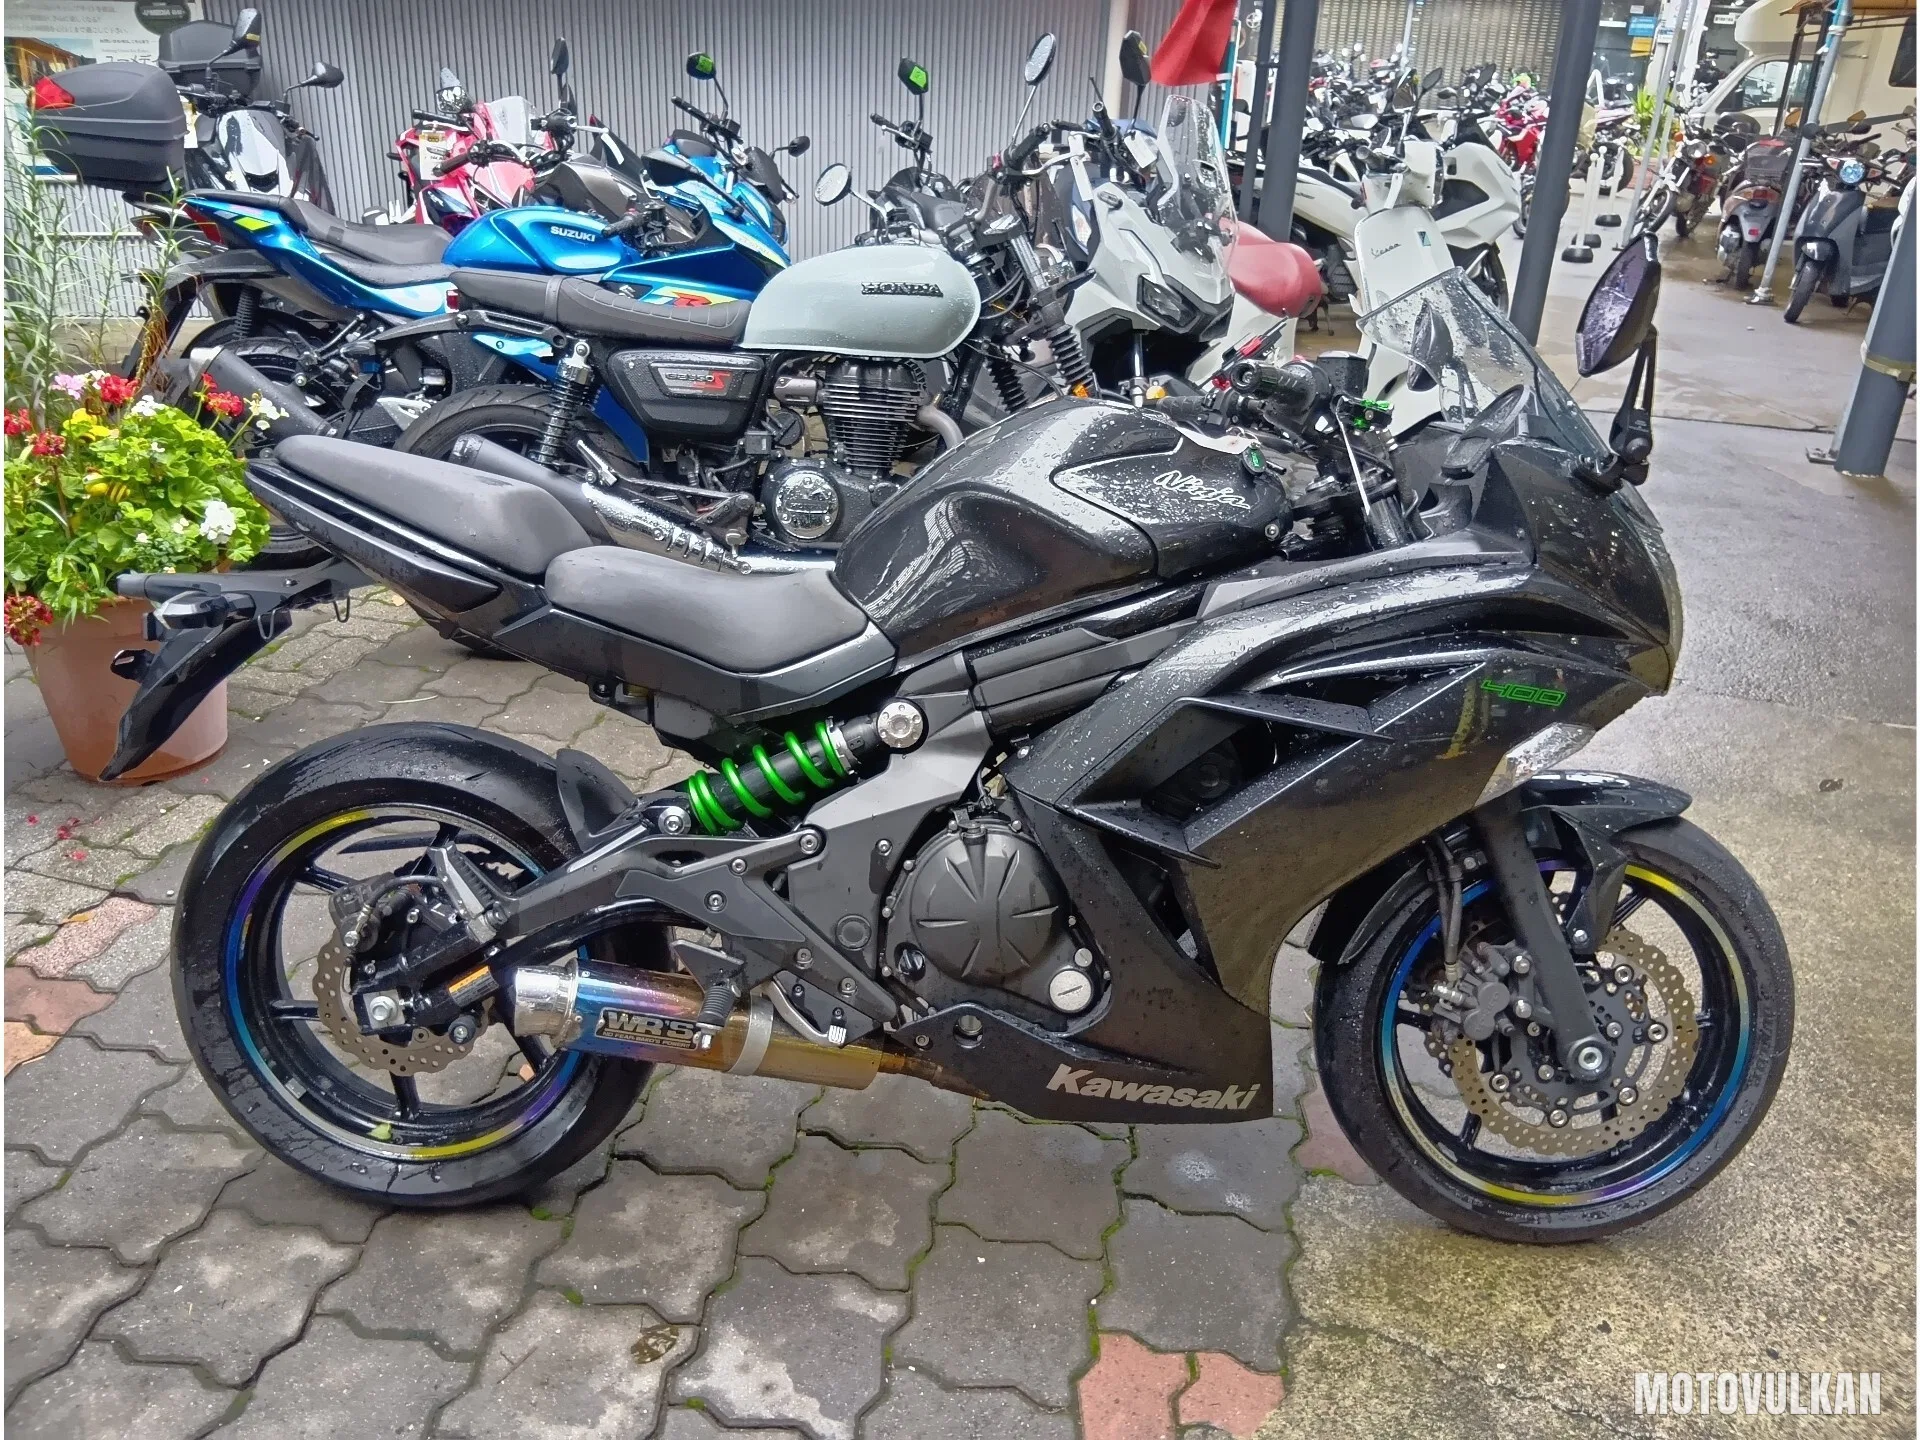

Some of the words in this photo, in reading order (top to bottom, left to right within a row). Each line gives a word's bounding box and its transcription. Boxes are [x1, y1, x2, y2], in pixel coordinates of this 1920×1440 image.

[550, 226, 596, 242] SUZUKI
[861, 282, 943, 298] HONDA
[1153, 470, 1251, 509] Ninja
[1480, 680, 1567, 706] 400
[607, 1011, 694, 1040] WR'S
[1045, 1063, 1261, 1110] Kawasaki
